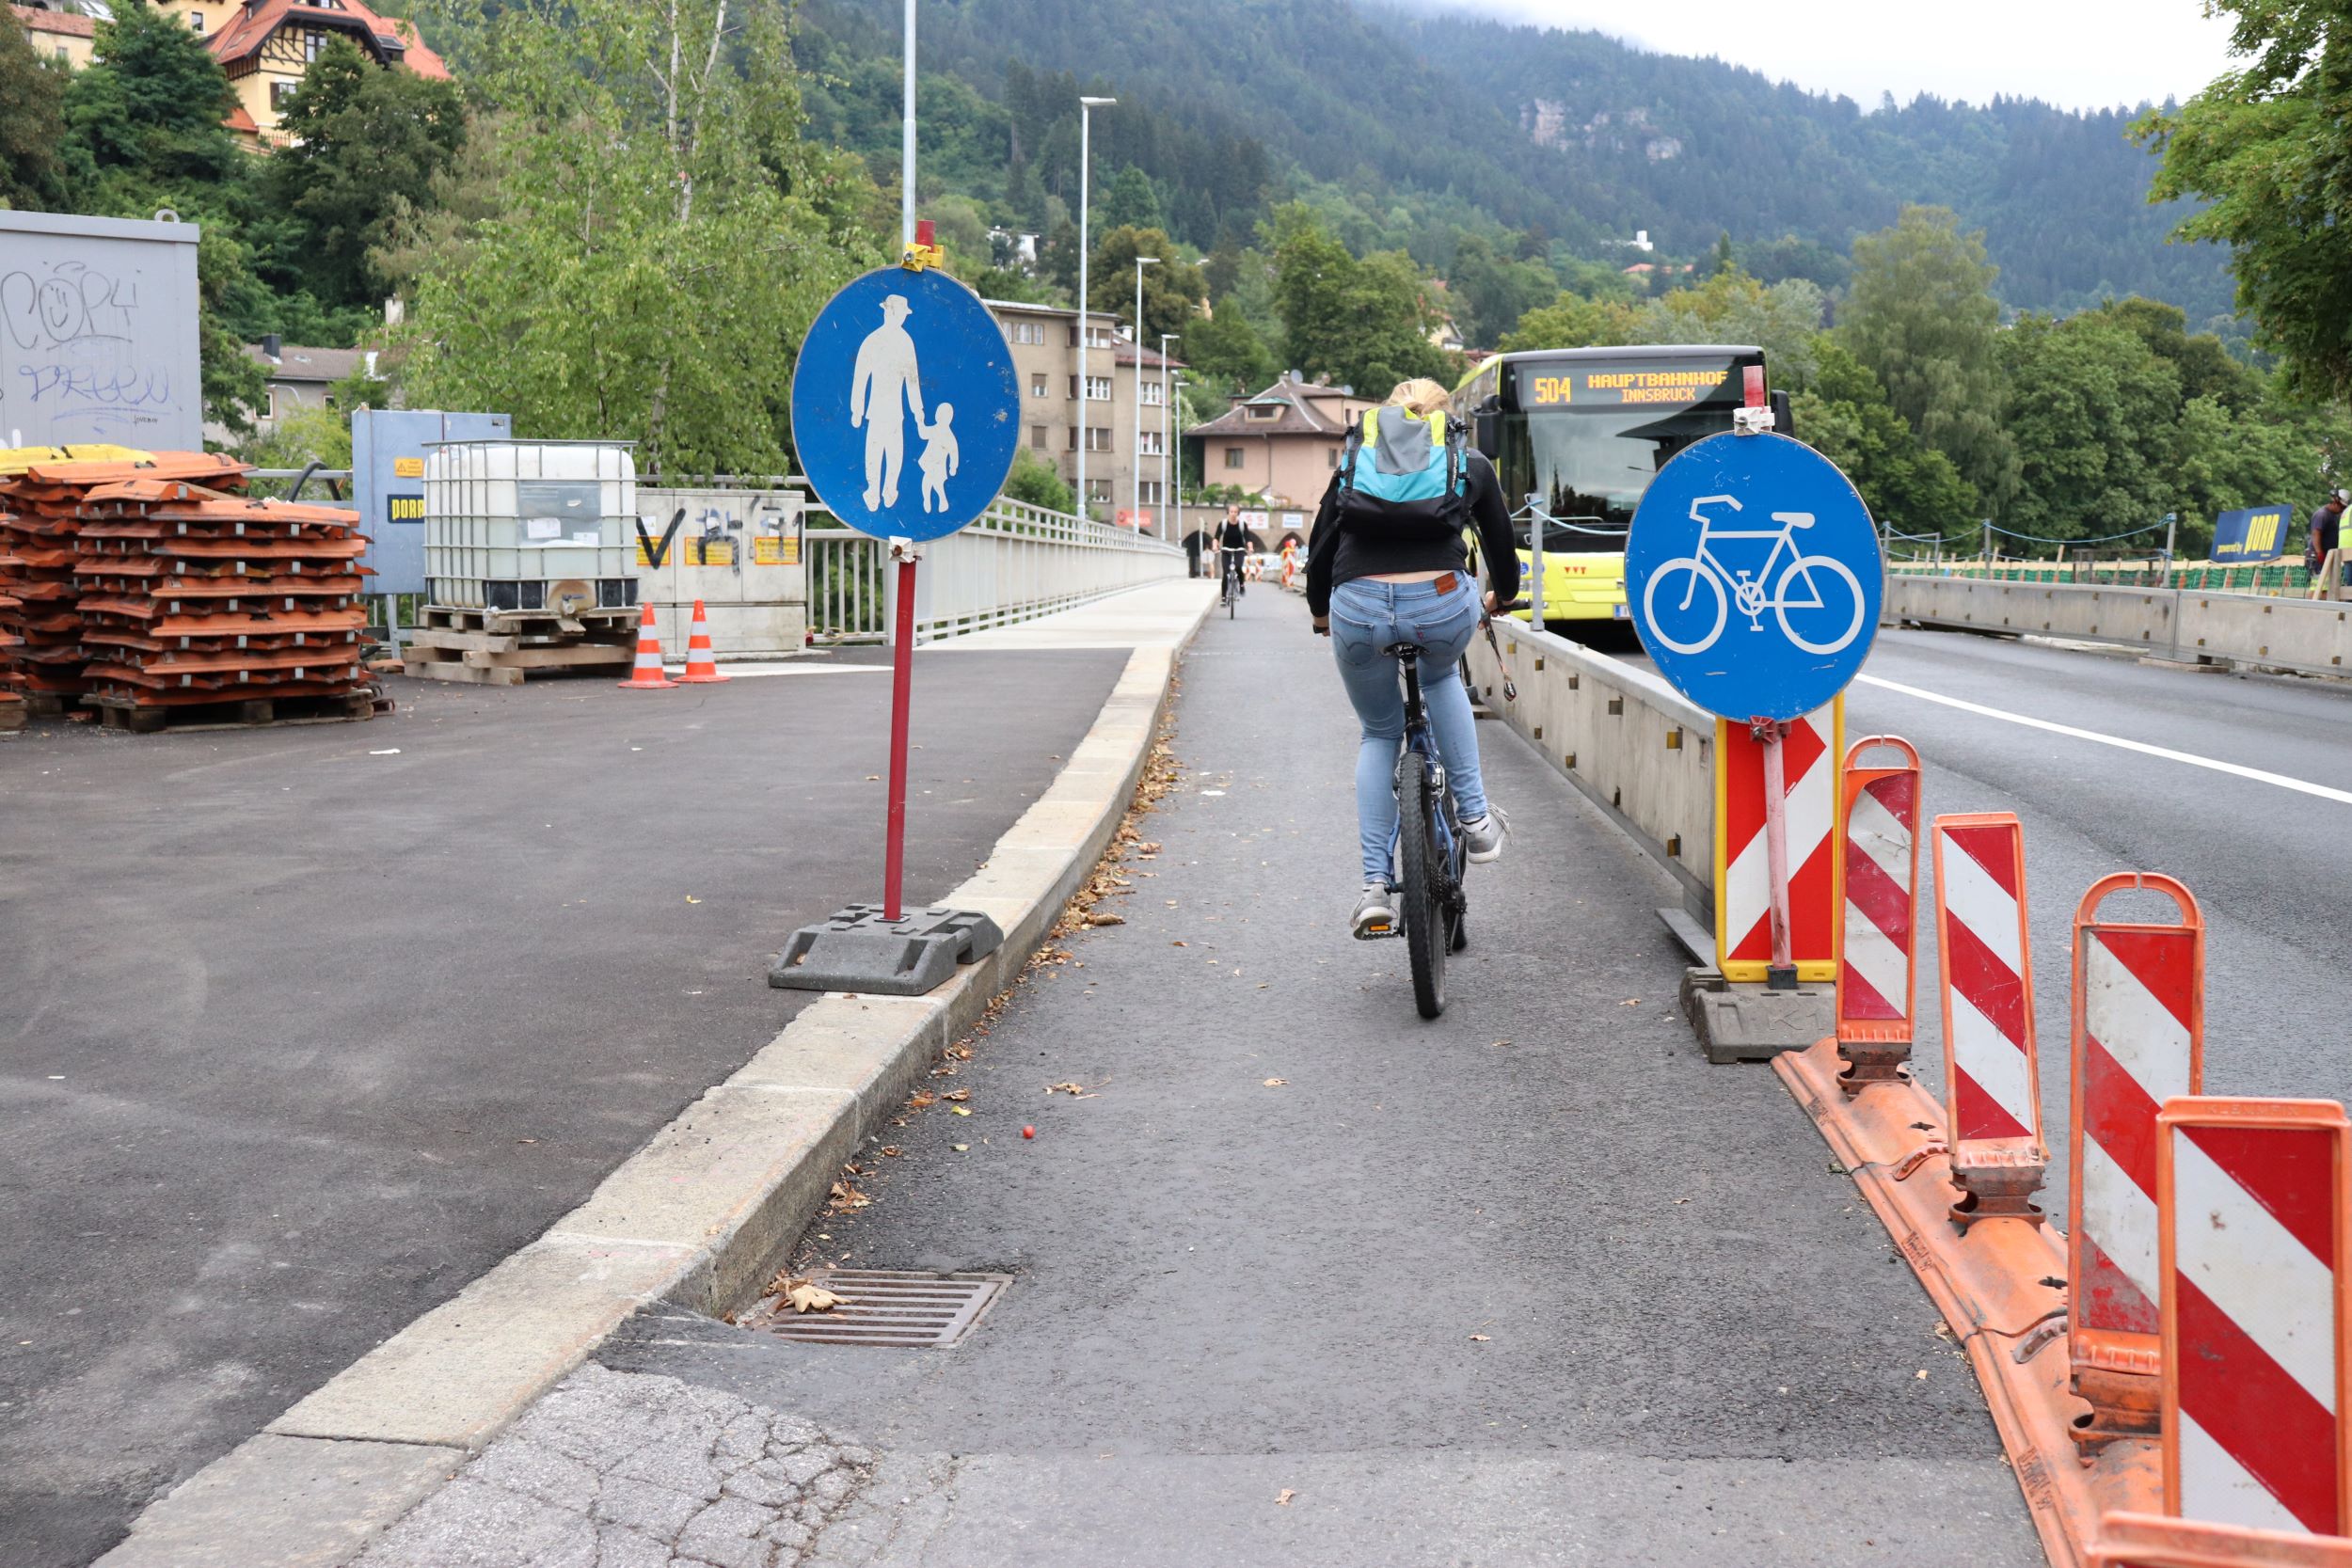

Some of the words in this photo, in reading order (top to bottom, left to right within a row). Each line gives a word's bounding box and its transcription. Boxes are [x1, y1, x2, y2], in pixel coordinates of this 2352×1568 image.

[1534, 377, 1571, 404] 504
[1588, 372, 1728, 388] HAUPTBAHNHOF
[1622, 388, 1696, 403] INNSBRUCK
[391, 499, 425, 520] PORR
[2244, 514, 2280, 555] PORR
